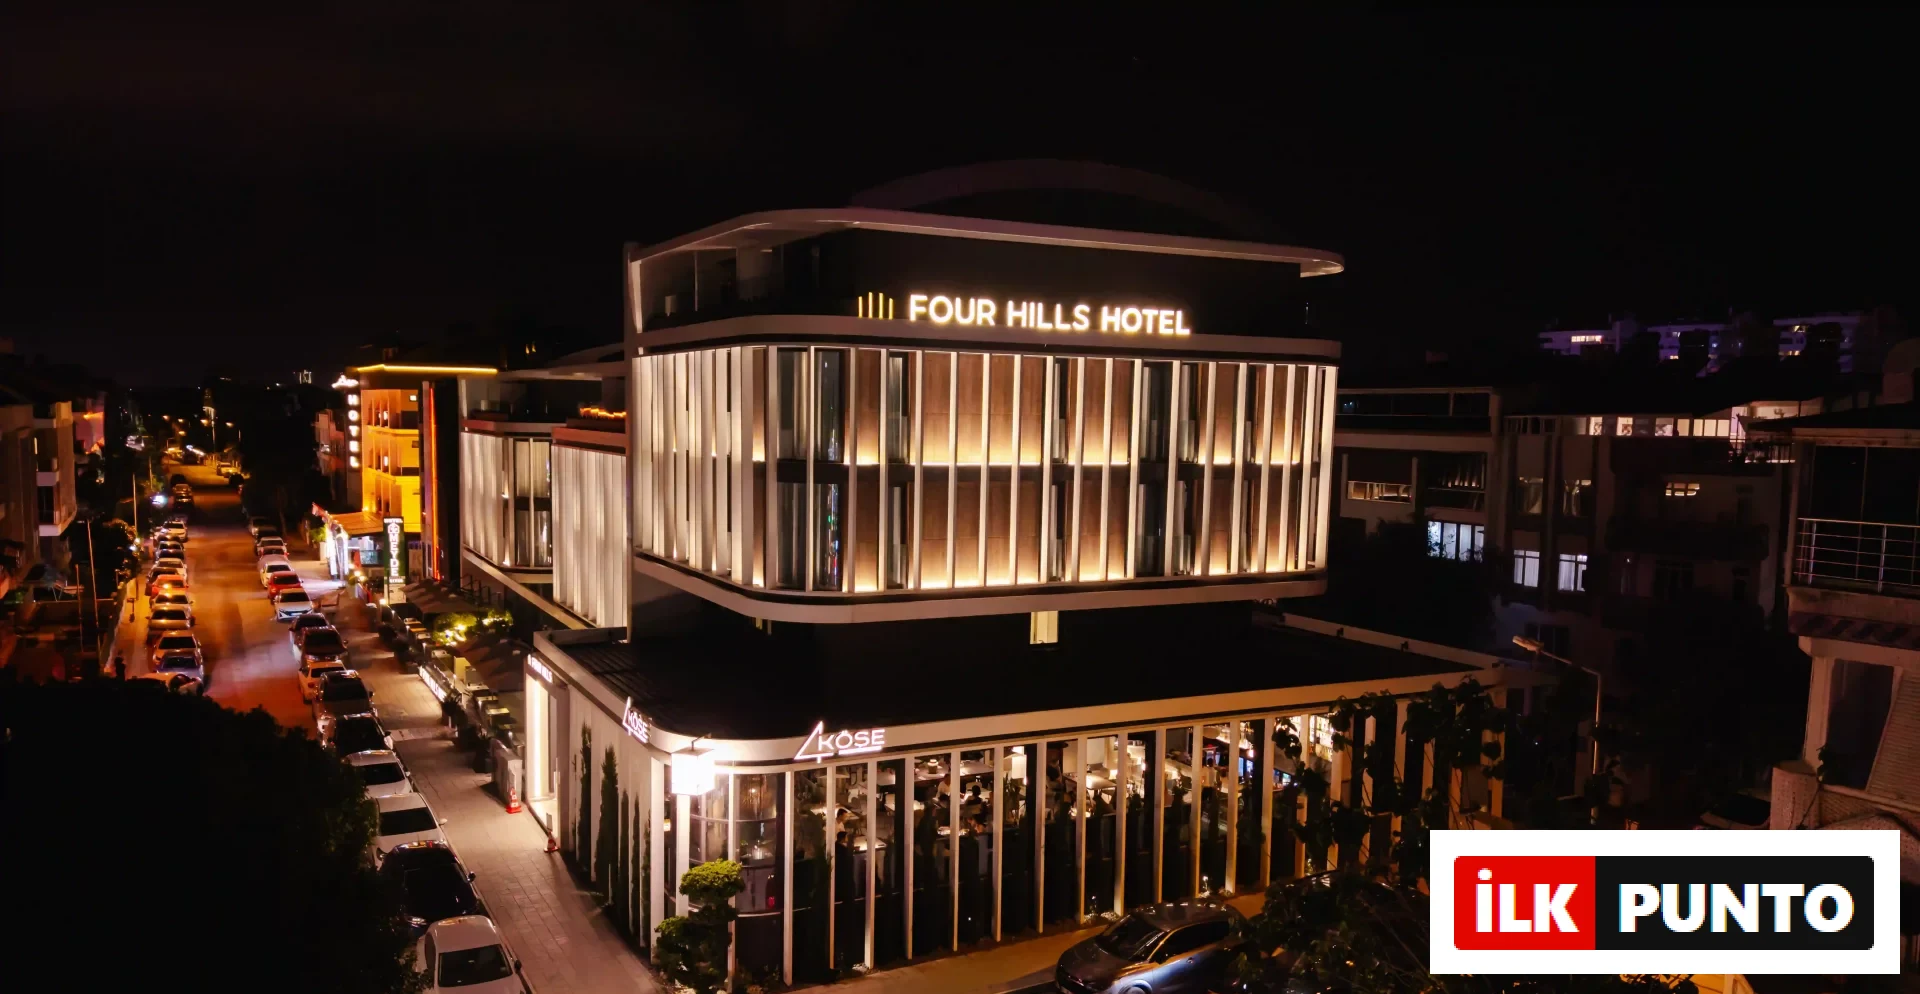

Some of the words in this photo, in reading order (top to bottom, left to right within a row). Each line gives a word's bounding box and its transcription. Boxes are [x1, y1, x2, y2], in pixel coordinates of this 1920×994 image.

[909, 294, 996, 326] FOUR
[1006, 300, 1090, 331] HILLS
[1101, 306, 1191, 335] HOTEL
[347, 393, 360, 469] HOTEL
